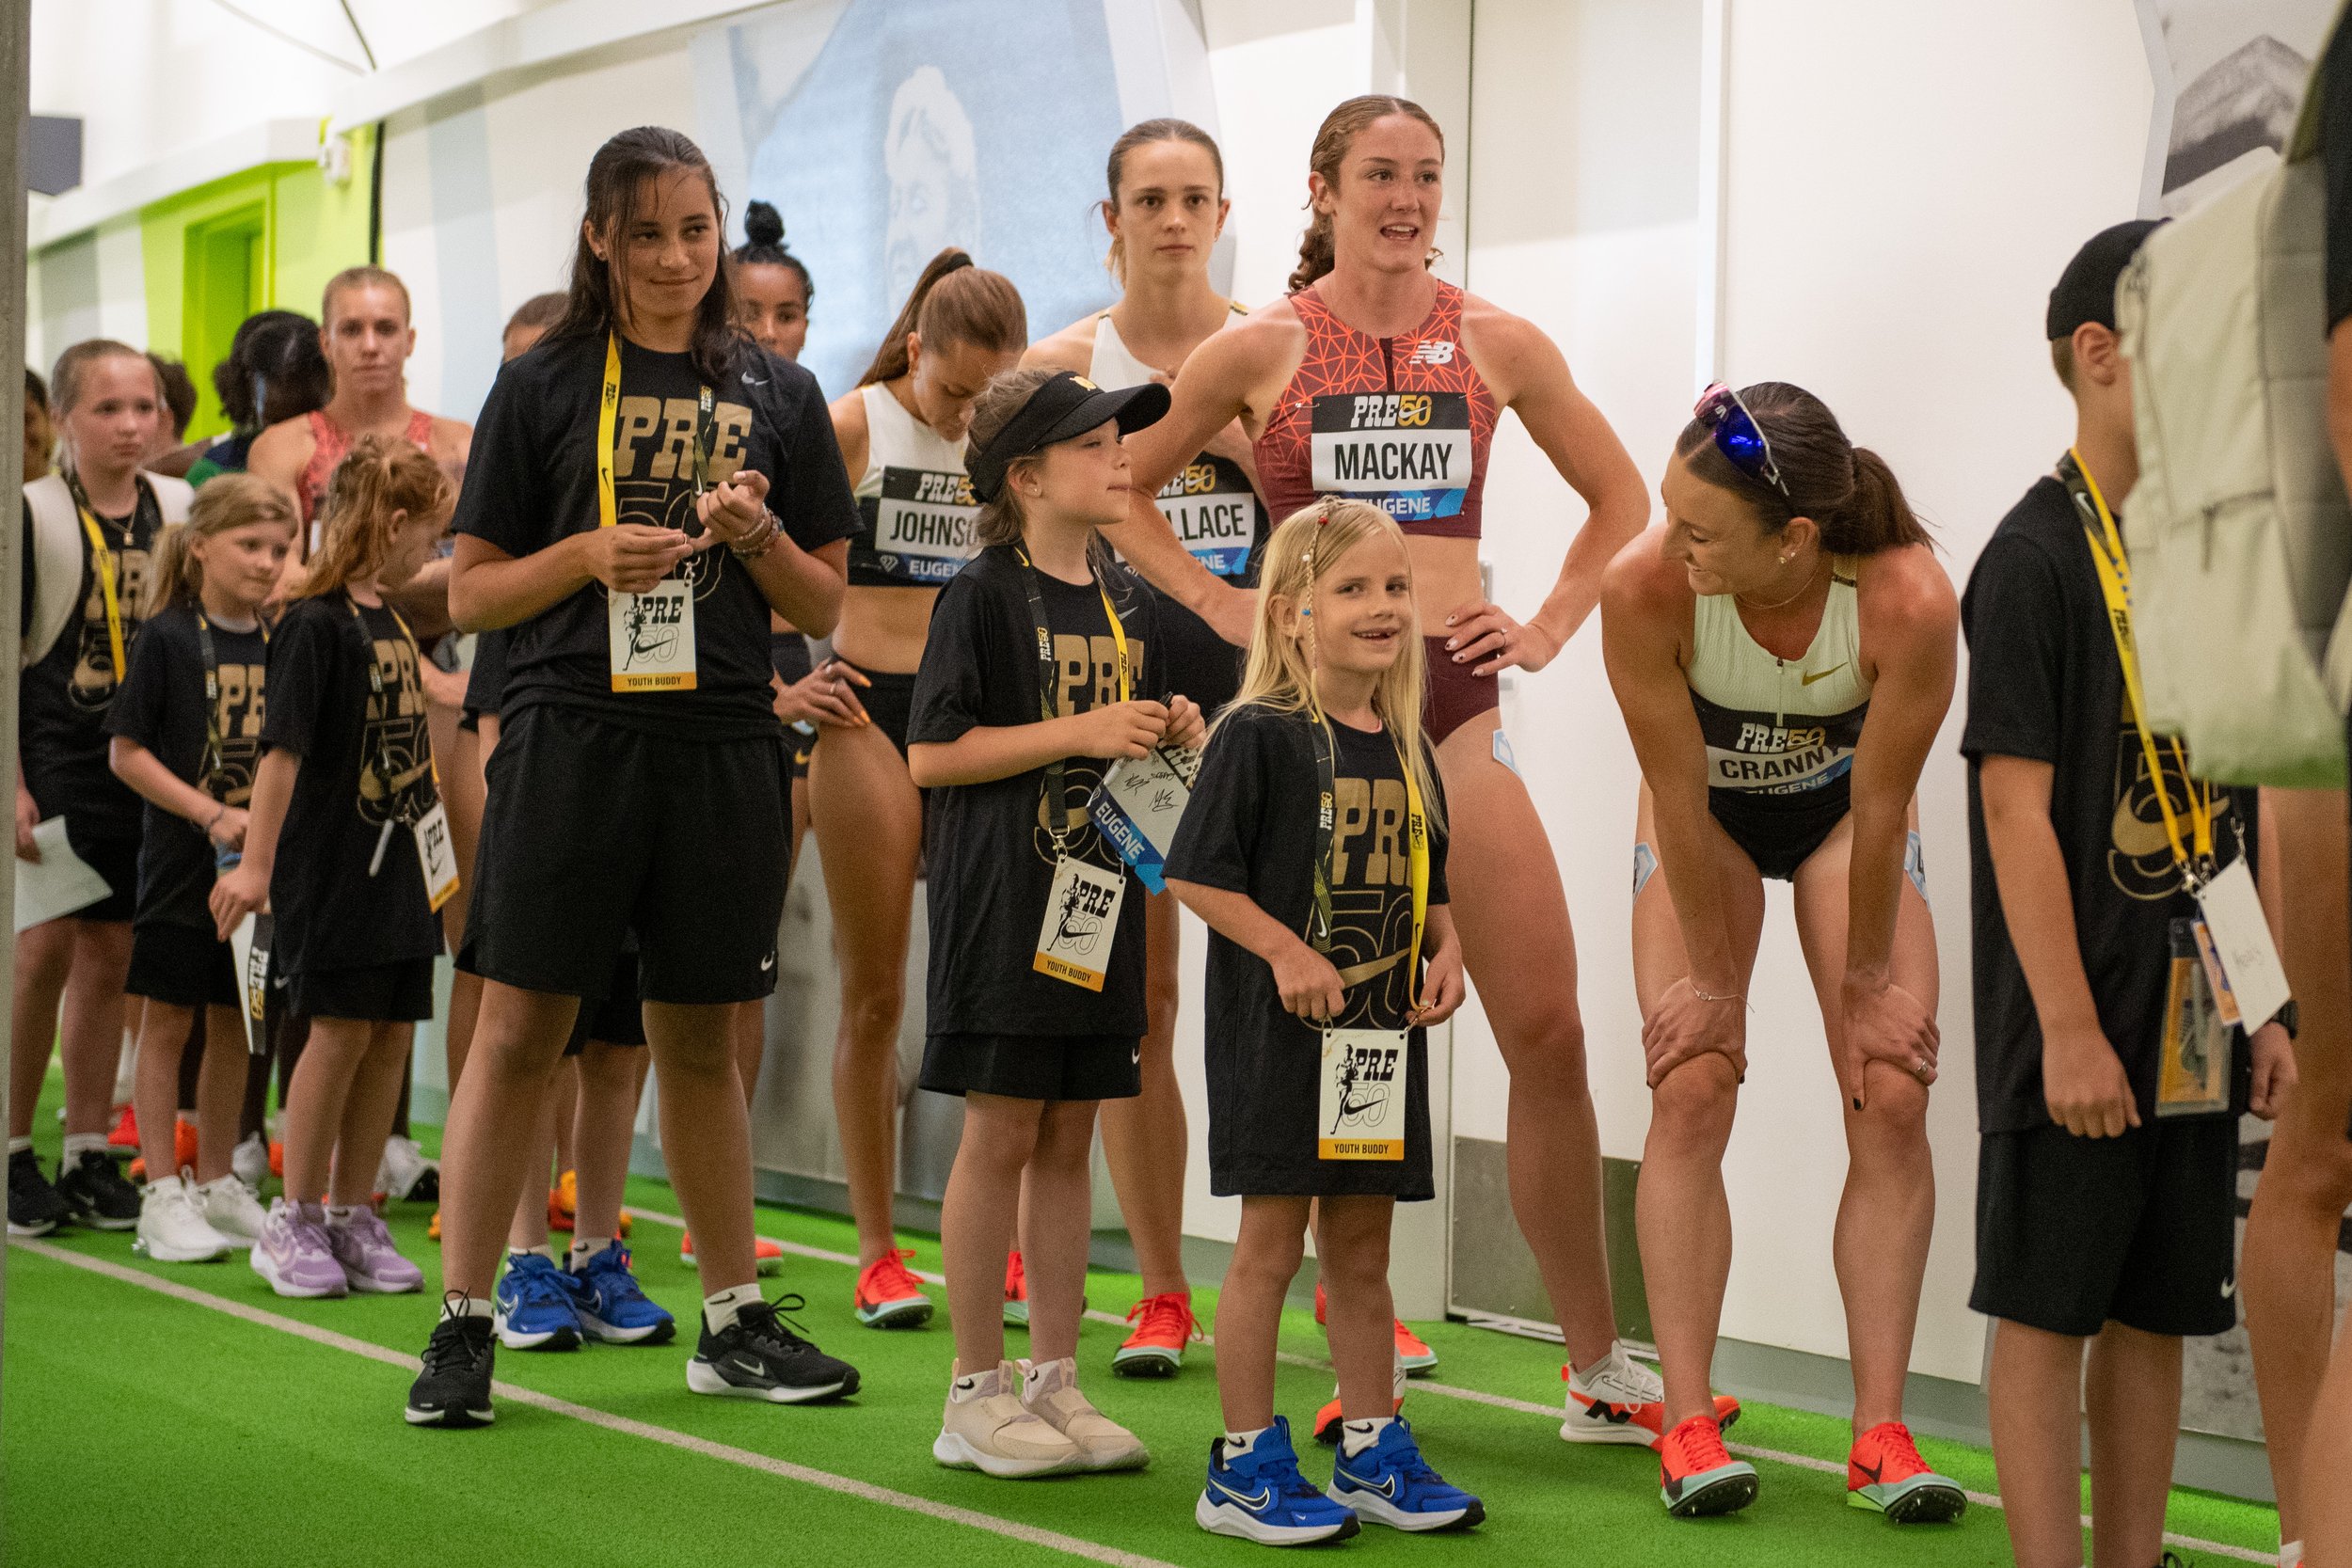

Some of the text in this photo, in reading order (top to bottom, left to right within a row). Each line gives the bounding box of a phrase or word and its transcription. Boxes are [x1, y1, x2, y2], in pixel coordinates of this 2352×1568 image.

[612, 395, 753, 483] PRE
[1334, 443, 1453, 481] MACKAY
[640, 595, 684, 624] PRE
[628, 675, 681, 687] YOUTH BUDDY
[1095, 801, 1145, 860] EUGENE
[1078, 879, 1117, 919] PRE
[1046, 959, 1092, 983] YOUTH BUDDY
[1355, 1048, 1399, 1082] PRE
[1334, 1143, 1389, 1154] YOUTH BUDDY
